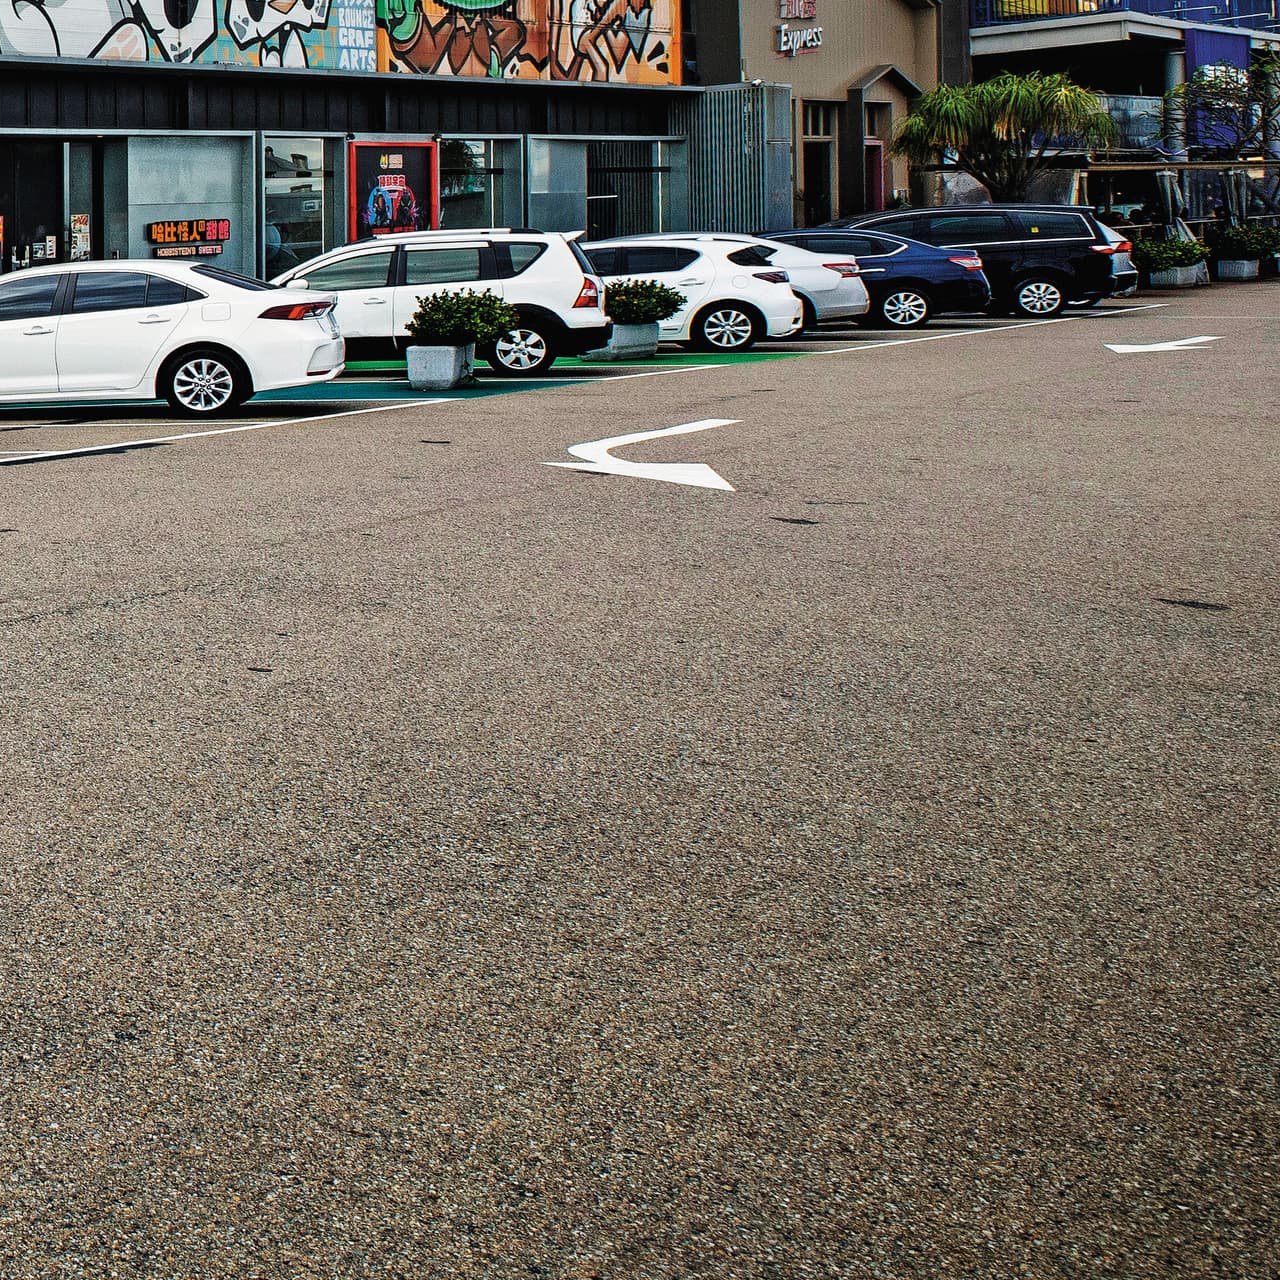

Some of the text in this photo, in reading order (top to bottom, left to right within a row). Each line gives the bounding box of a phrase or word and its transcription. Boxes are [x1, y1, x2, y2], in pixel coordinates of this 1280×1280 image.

[338, 8, 374, 29] BOUNCE
[339, 27, 374, 48] GRAF
[780, 24, 823, 57] Express
[339, 49, 376, 72] ARTS
